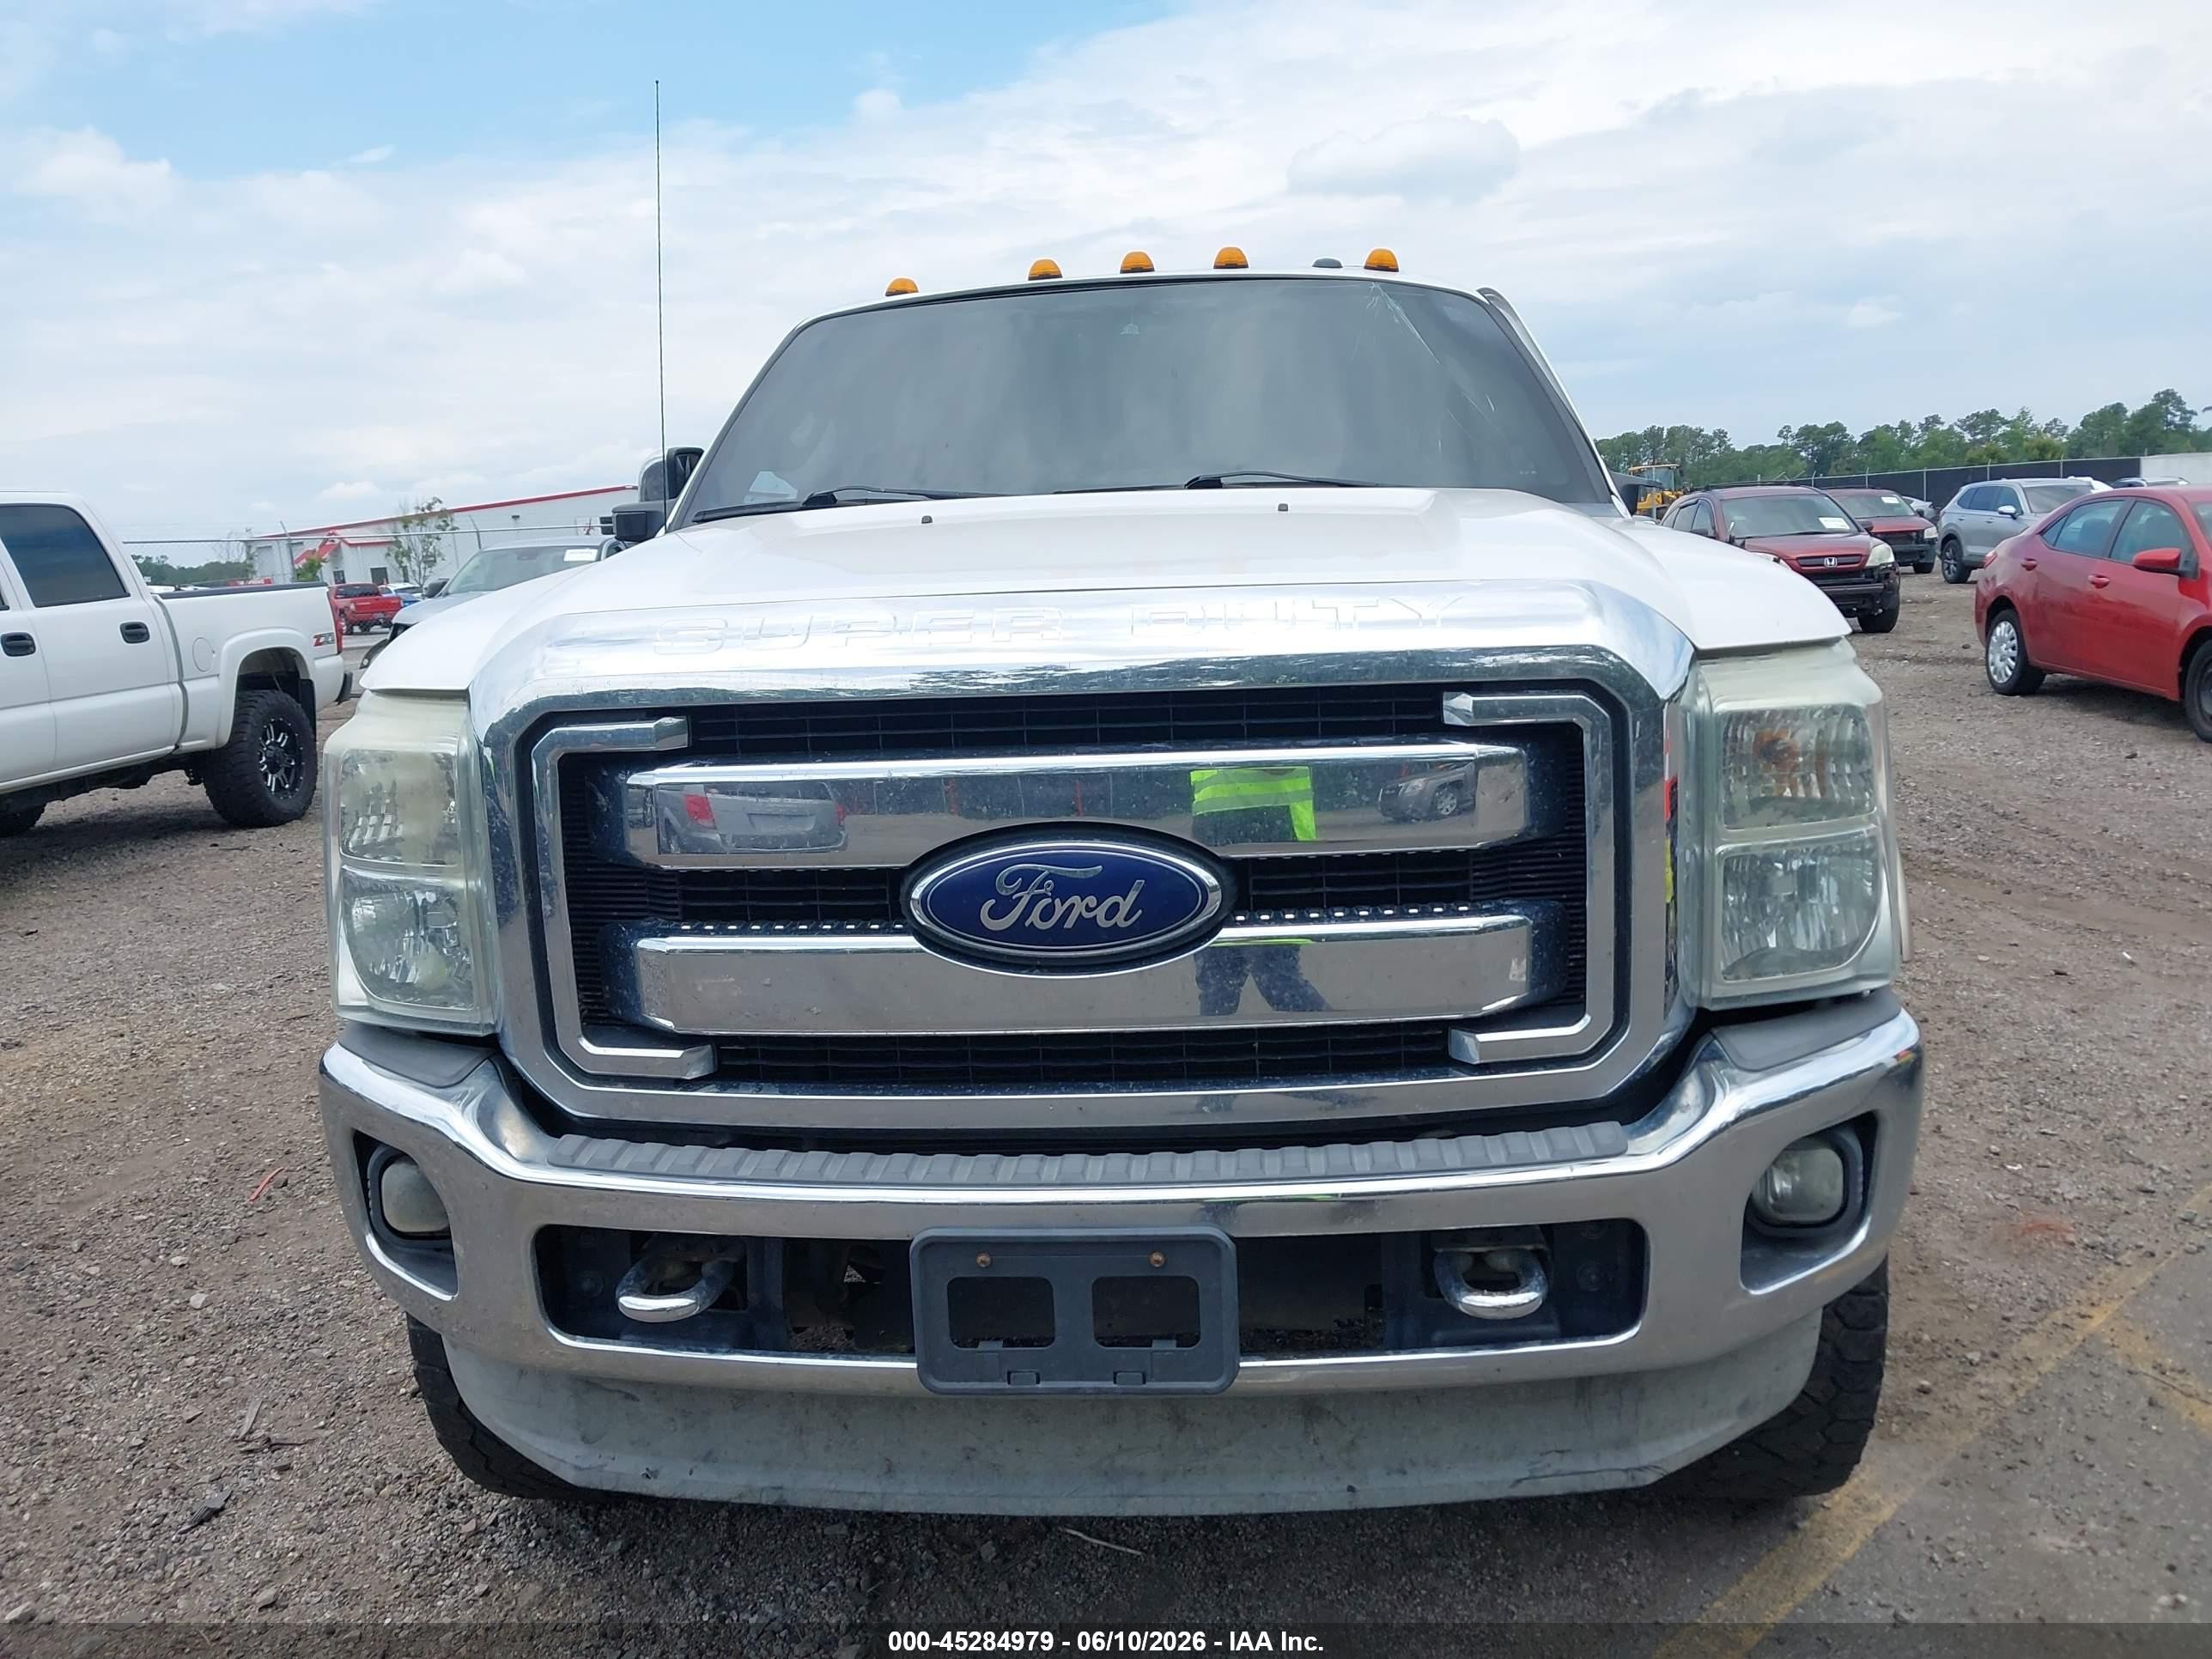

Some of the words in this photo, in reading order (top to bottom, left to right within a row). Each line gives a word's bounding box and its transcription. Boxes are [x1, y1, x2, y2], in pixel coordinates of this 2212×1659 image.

[653, 605, 1065, 655] SUPER
[1128, 594, 1465, 637] DUTY
[980, 863, 1145, 931] Ford
